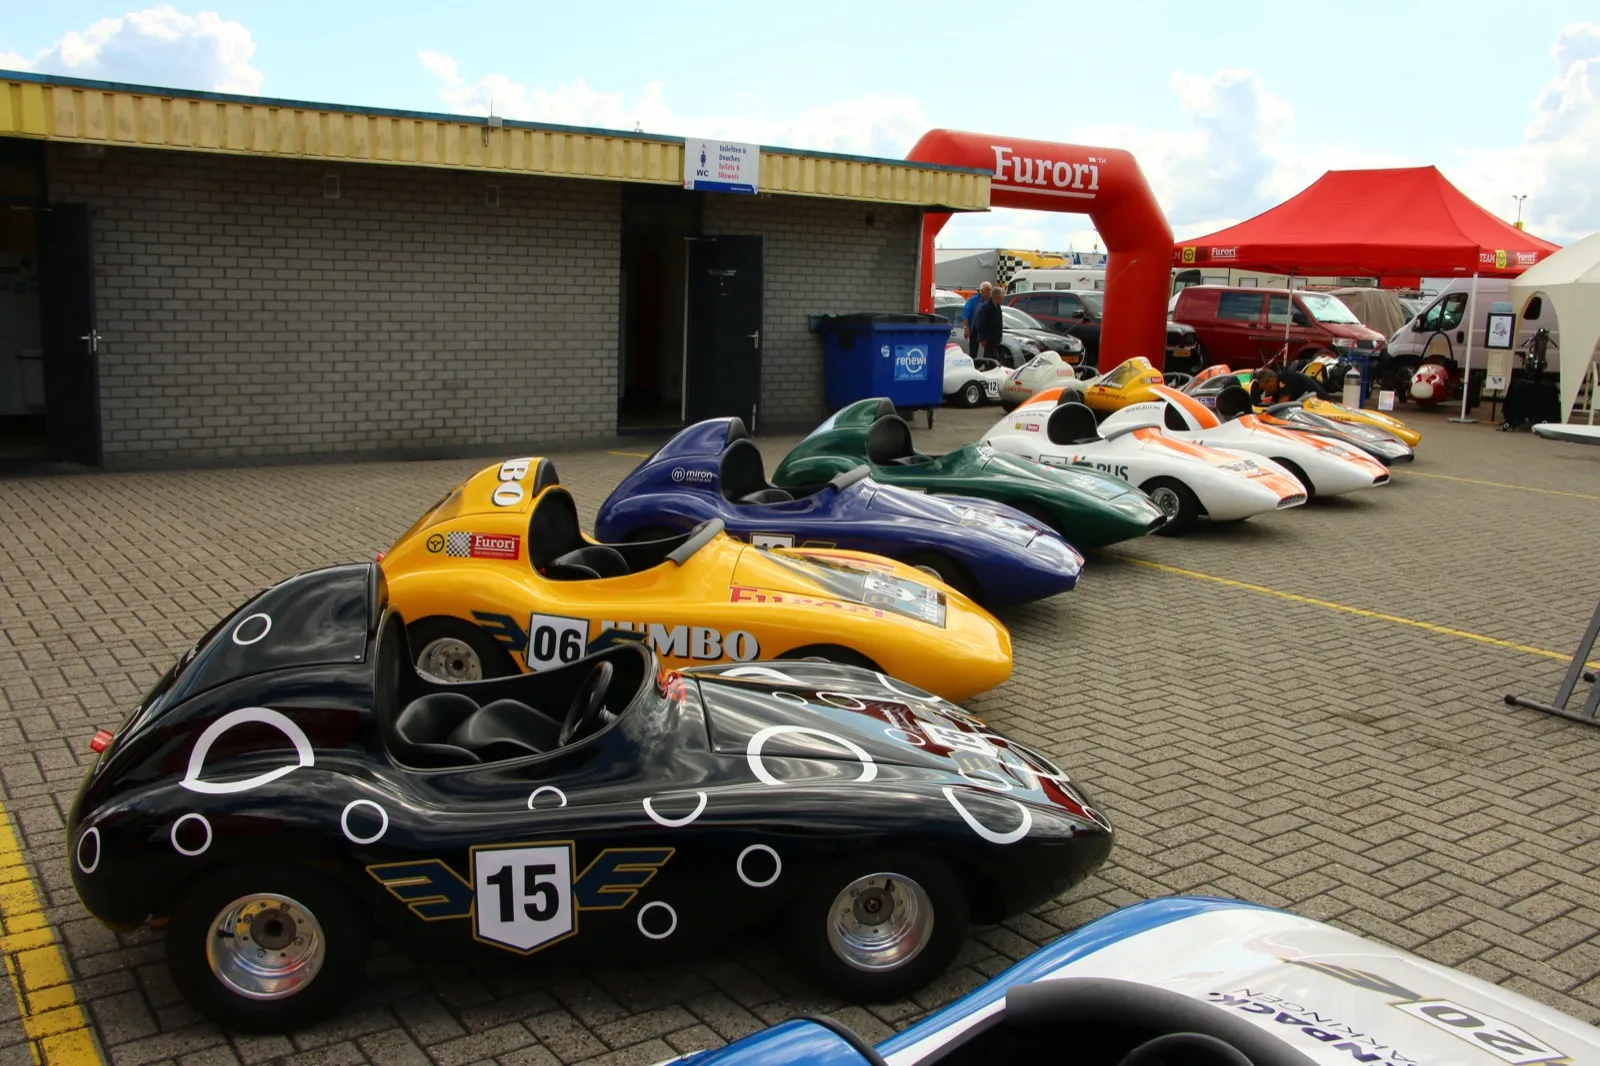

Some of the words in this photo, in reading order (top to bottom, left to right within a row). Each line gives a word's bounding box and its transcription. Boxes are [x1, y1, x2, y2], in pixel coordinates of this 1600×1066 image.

[719, 154, 740, 162] Douches
[696, 169, 709, 177] WC
[719, 163, 735, 171] Toilets
[990, 145, 1099, 190] Furori
[718, 172, 739, 180] Showers
[1479, 253, 1496, 263] TEAM
[896, 356, 927, 366] renewi
[989, 381, 997, 392] 12
[686, 469, 713, 479] miron
[492, 458, 530, 507] BO
[474, 535, 516, 550] Furori
[533, 625, 583, 664] 06
[600, 619, 760, 663] MBO
[486, 863, 560, 923] 15
[1232, 988, 1418, 1064] AKKINGEN
[1419, 1005, 1549, 1056] 20
